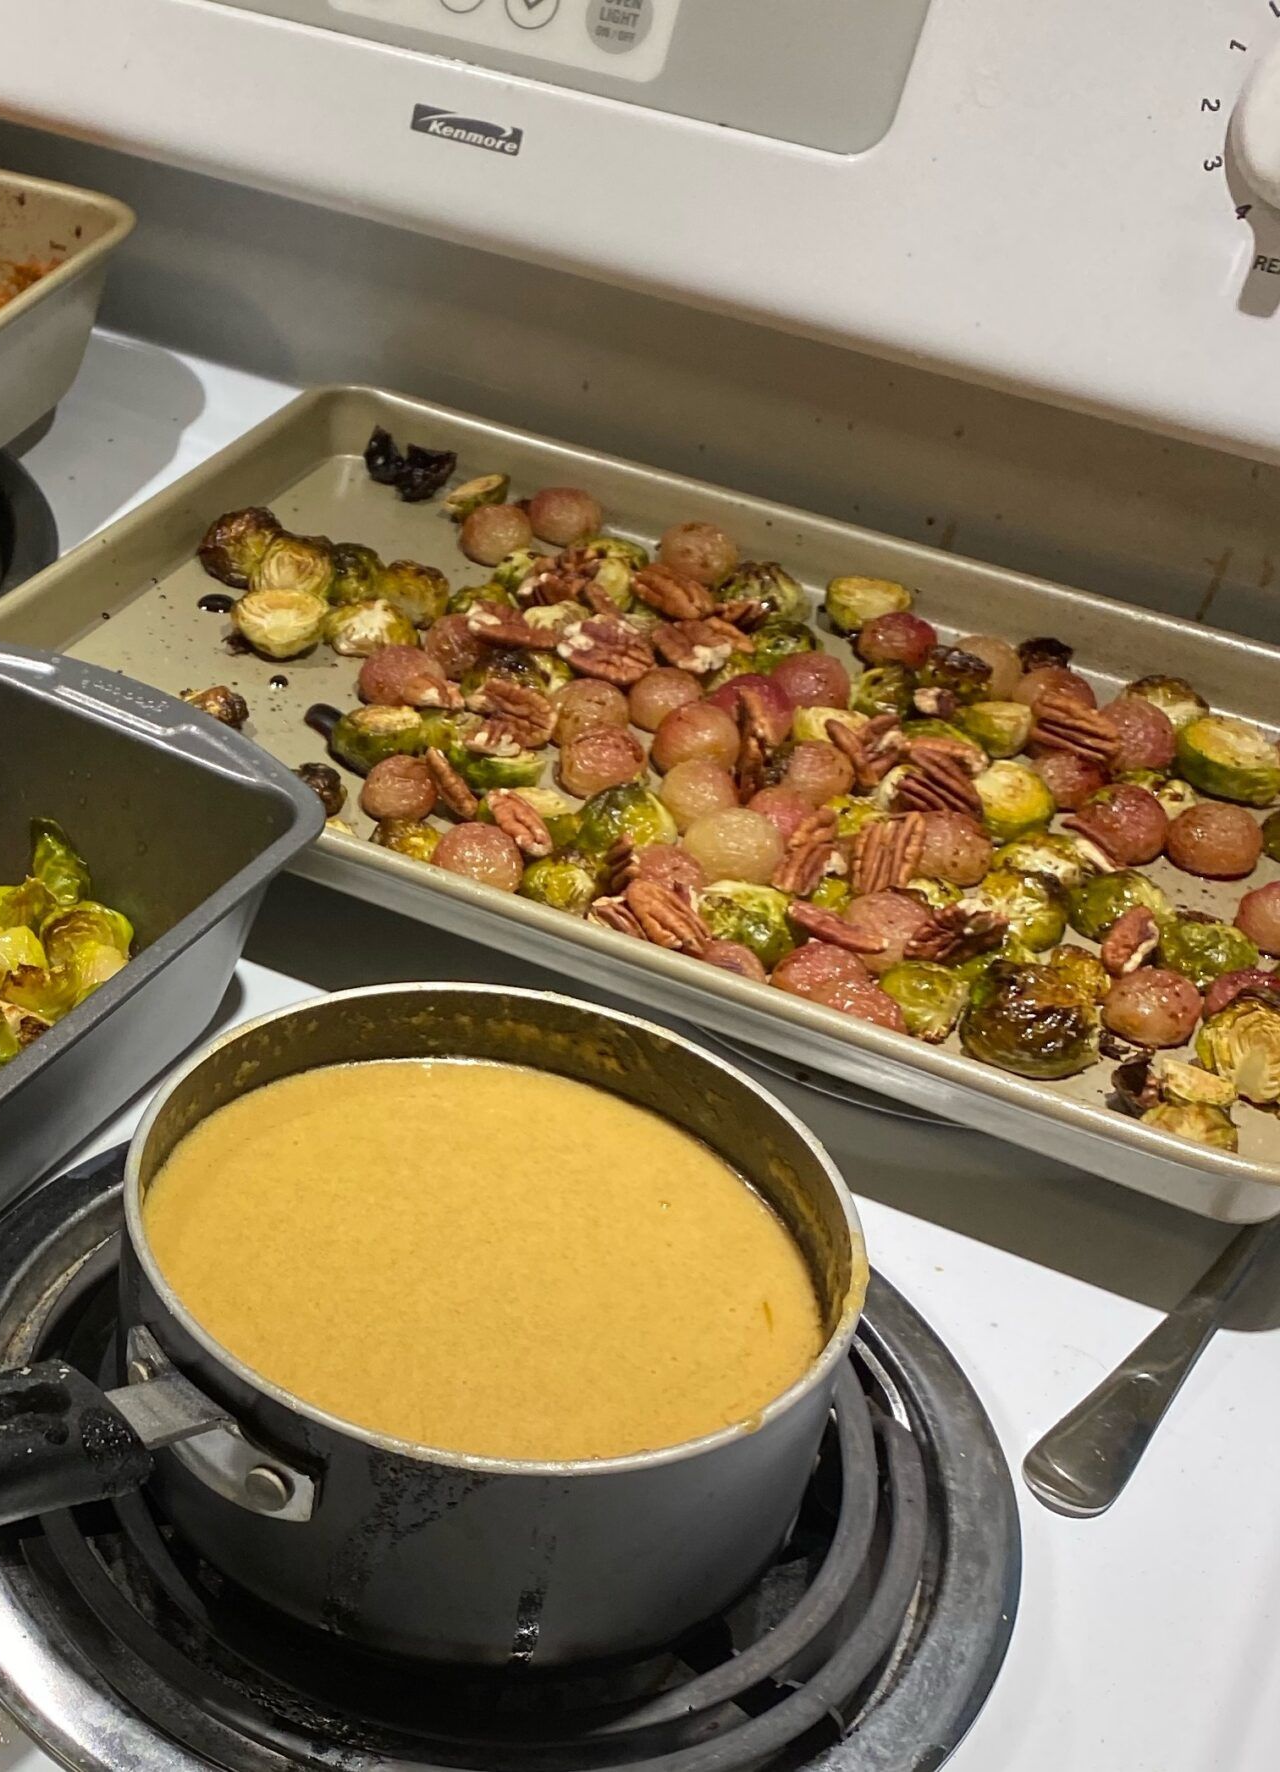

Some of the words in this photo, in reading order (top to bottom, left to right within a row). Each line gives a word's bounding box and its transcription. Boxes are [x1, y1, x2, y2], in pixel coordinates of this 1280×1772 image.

[600, 6, 640, 28] LIGHT
[1230, 40, 1247, 52] 1
[1201, 98, 1220, 112] 2
[428, 119, 518, 152] Kenmore
[1203, 155, 1222, 171] 3
[1235, 204, 1252, 220] 4
